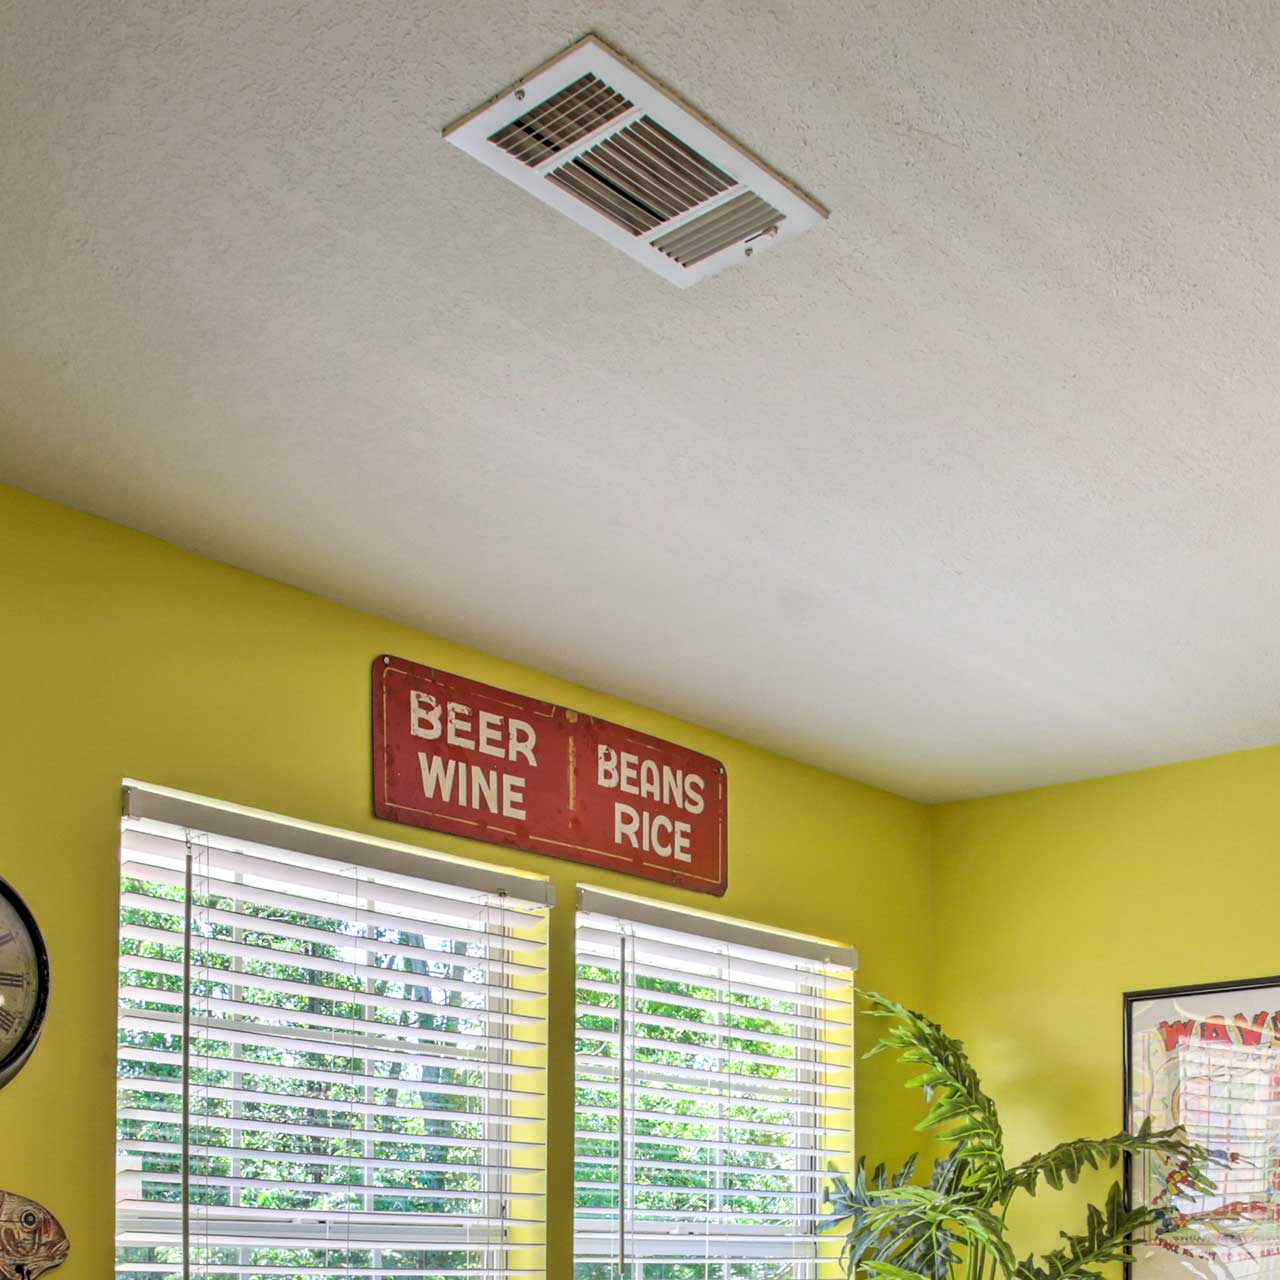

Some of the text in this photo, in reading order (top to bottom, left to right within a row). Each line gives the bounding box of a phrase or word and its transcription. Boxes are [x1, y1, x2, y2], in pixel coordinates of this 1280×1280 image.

[410, 690, 537, 767] BEER
[418, 751, 527, 821] WINE
[597, 744, 705, 815] BEANS
[614, 802, 692, 863] RICE
